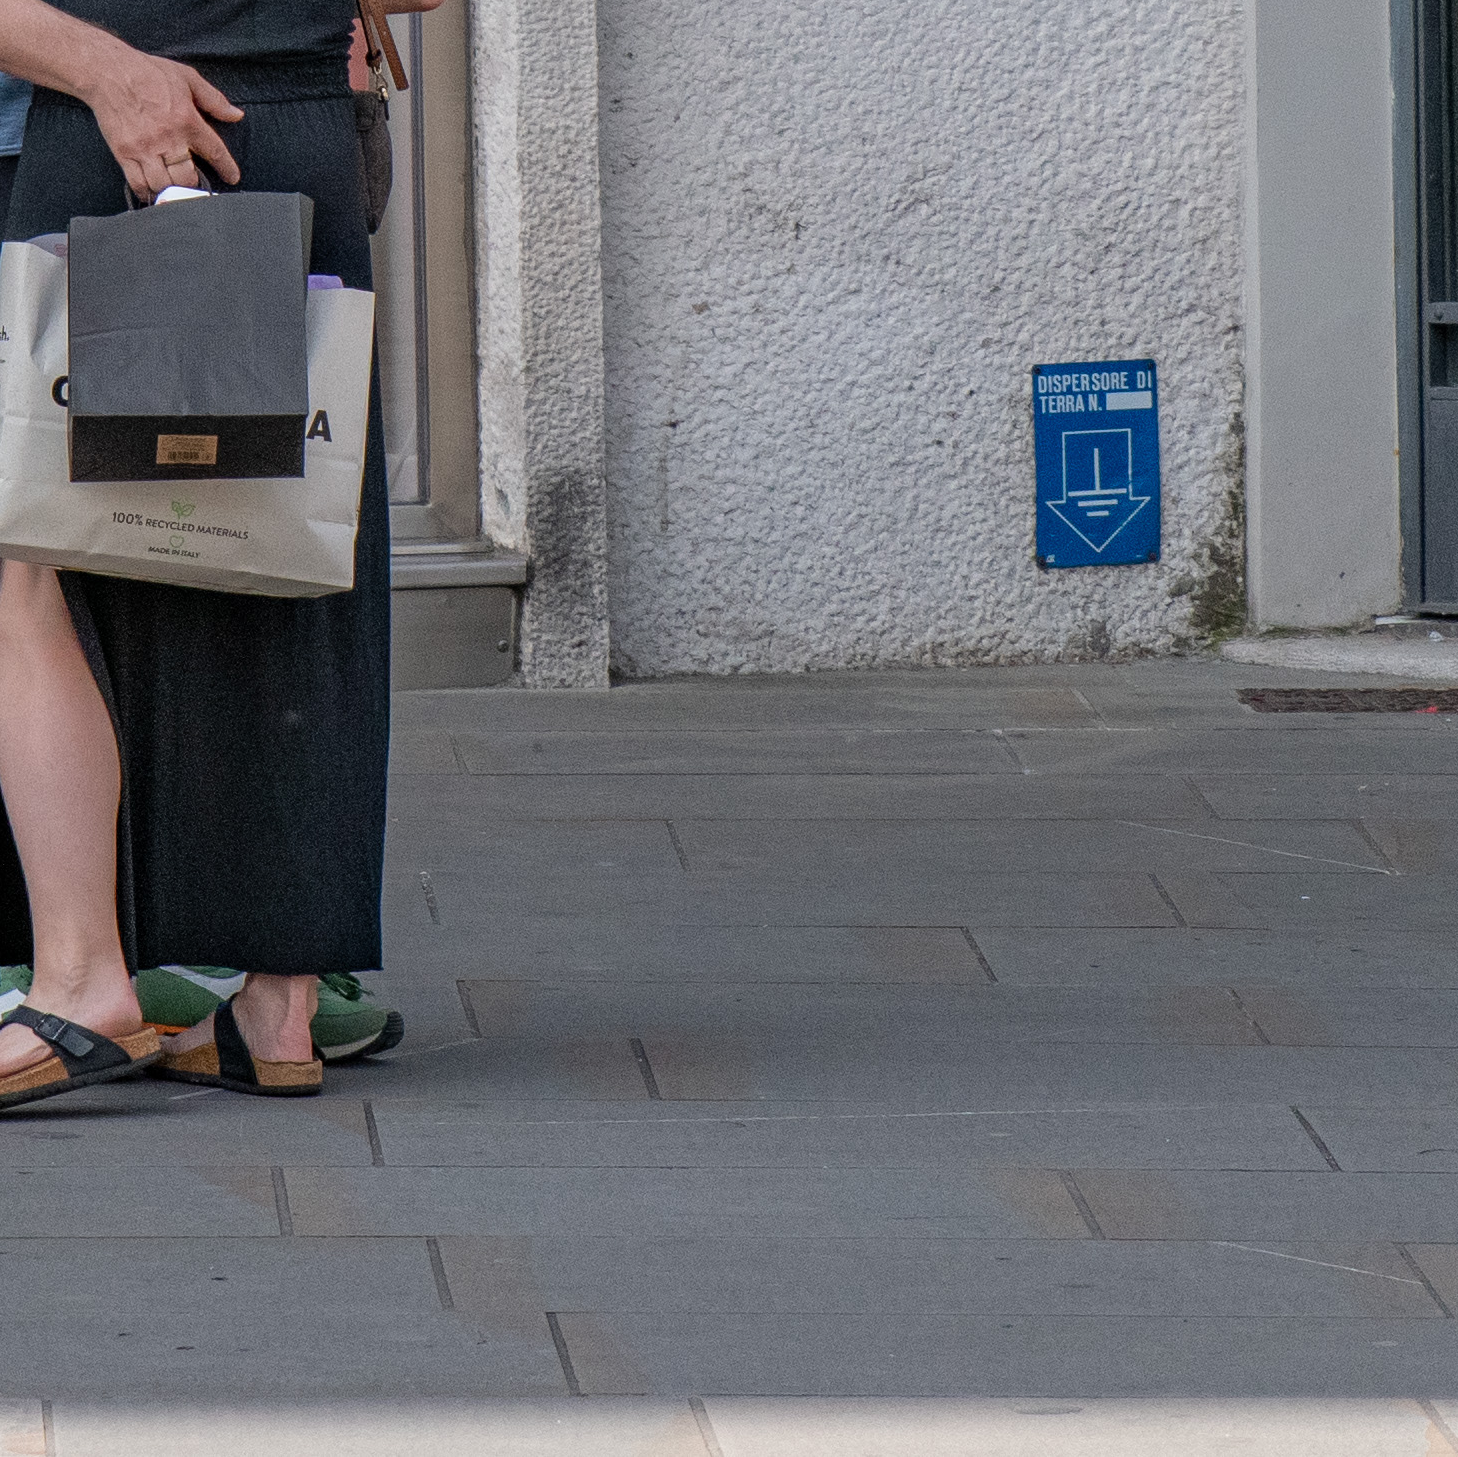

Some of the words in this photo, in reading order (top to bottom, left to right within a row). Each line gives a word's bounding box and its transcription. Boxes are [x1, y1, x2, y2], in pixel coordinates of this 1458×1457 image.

[1037, 371, 1130, 394] DISPERSORE
[1136, 370, 1153, 389] DI
[1038, 394, 1085, 415] TERRA
[1088, 393, 1103, 412] N.
[112, 511, 144, 526] 100%
[145, 518, 195, 533] RECYCLED
[196, 525, 249, 540] MATERIALS
[148, 546, 170, 556] MADE
[171, 547, 180, 556] IN
[180, 549, 200, 559] ITALY
